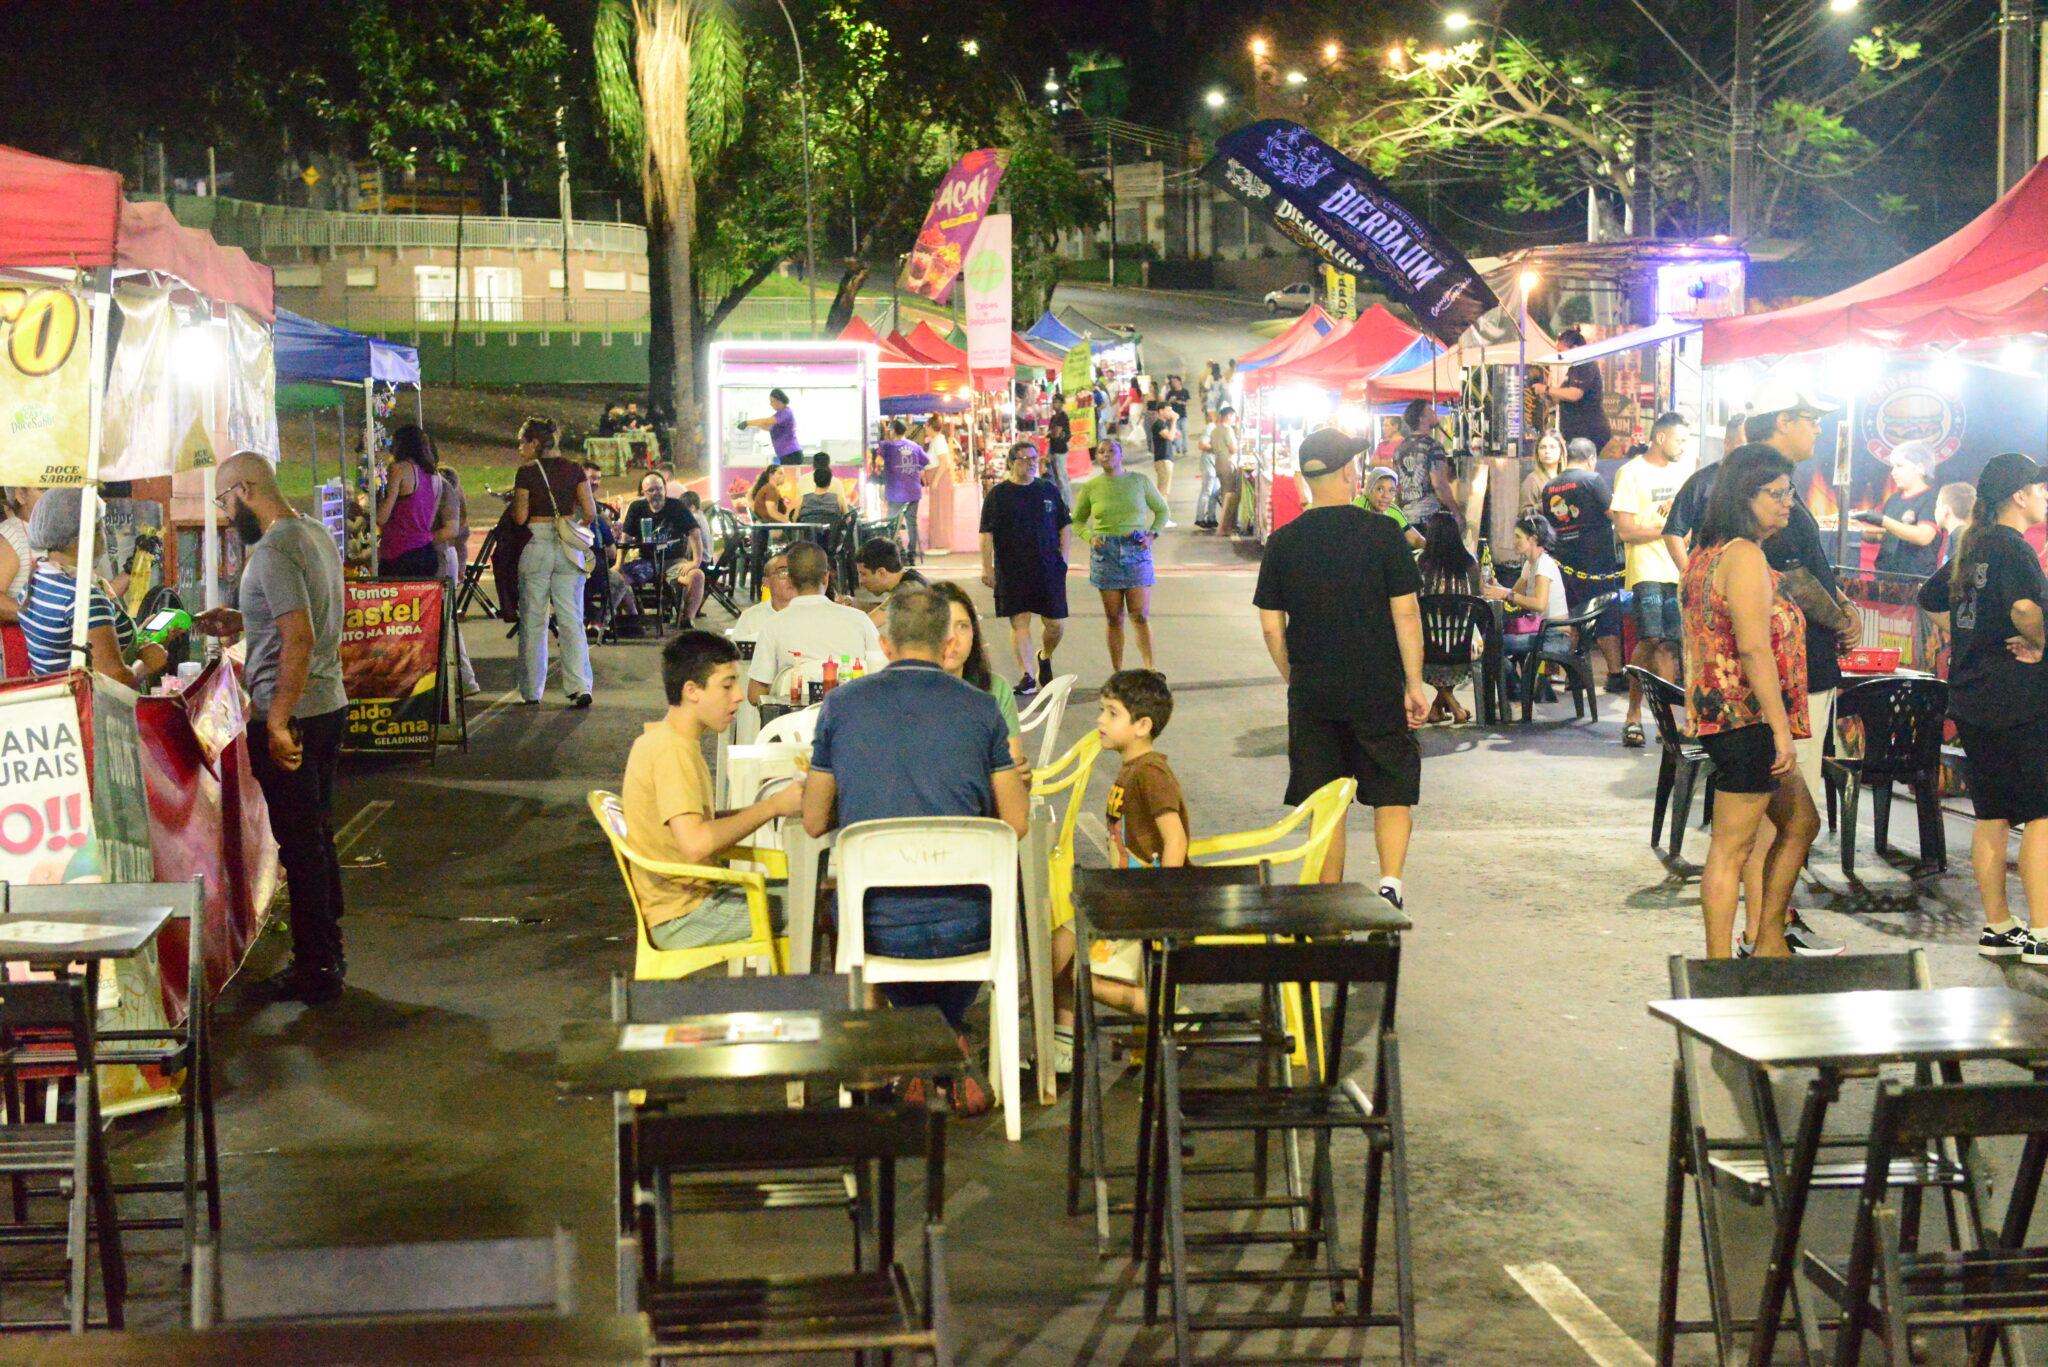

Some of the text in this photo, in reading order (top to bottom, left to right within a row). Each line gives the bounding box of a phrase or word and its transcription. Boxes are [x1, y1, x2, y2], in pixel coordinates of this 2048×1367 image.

[1318, 182, 1445, 292] BIERBAUM
[45, 465, 80, 474] DOCE
[39, 474, 82, 484] SABOR
[349, 586, 399, 600] Temos
[345, 597, 420, 629] astel
[342, 624, 422, 642] ITO NA HORA
[347, 704, 392, 721] aldo
[349, 719, 430, 736] de Cana
[1, 722, 78, 757] ANA
[374, 735, 429, 745] GELADINHO
